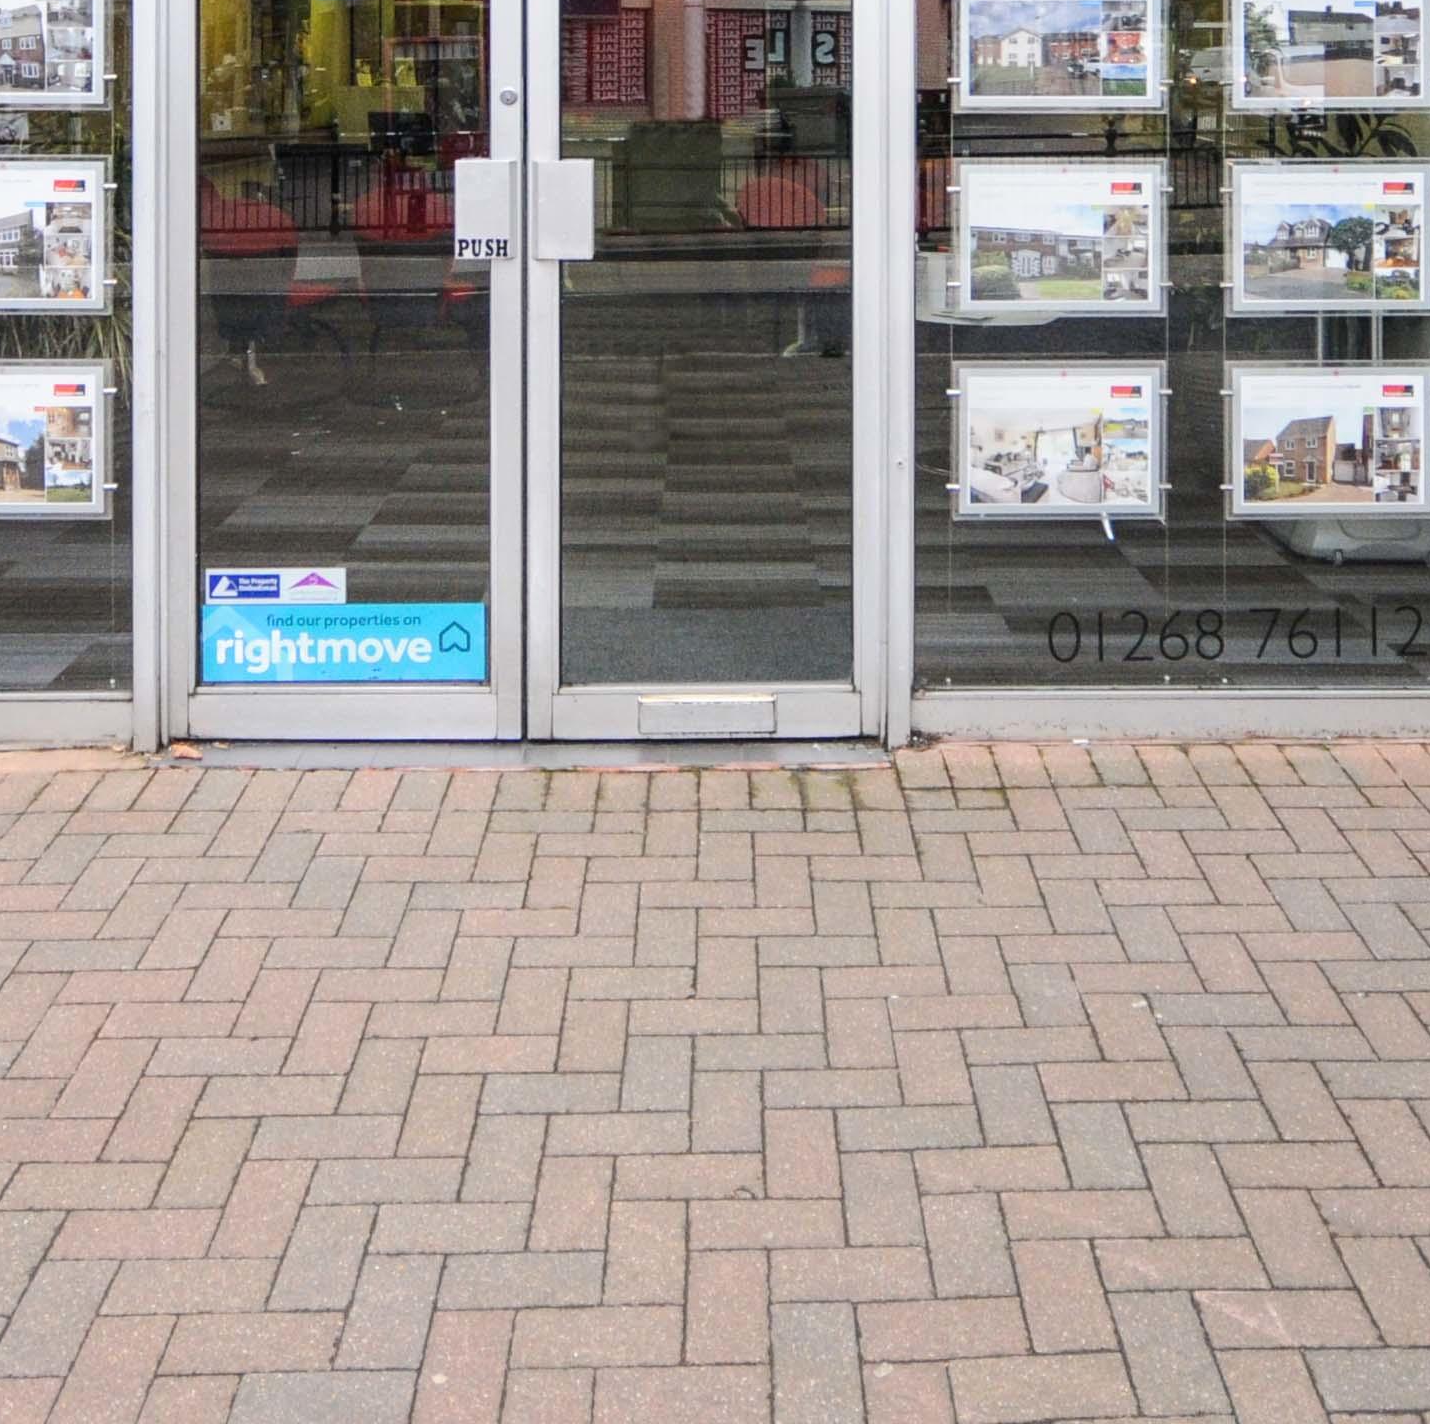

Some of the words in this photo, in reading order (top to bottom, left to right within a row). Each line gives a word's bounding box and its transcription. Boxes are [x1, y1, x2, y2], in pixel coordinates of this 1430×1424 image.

[457, 238, 509, 258] PUSH
[266, 613, 293, 627] find
[297, 616, 322, 627] our
[324, 613, 401, 630] properties
[403, 616, 422, 626] on
[1046, 608, 1226, 664] 01268
[215, 629, 433, 675] rightmove
